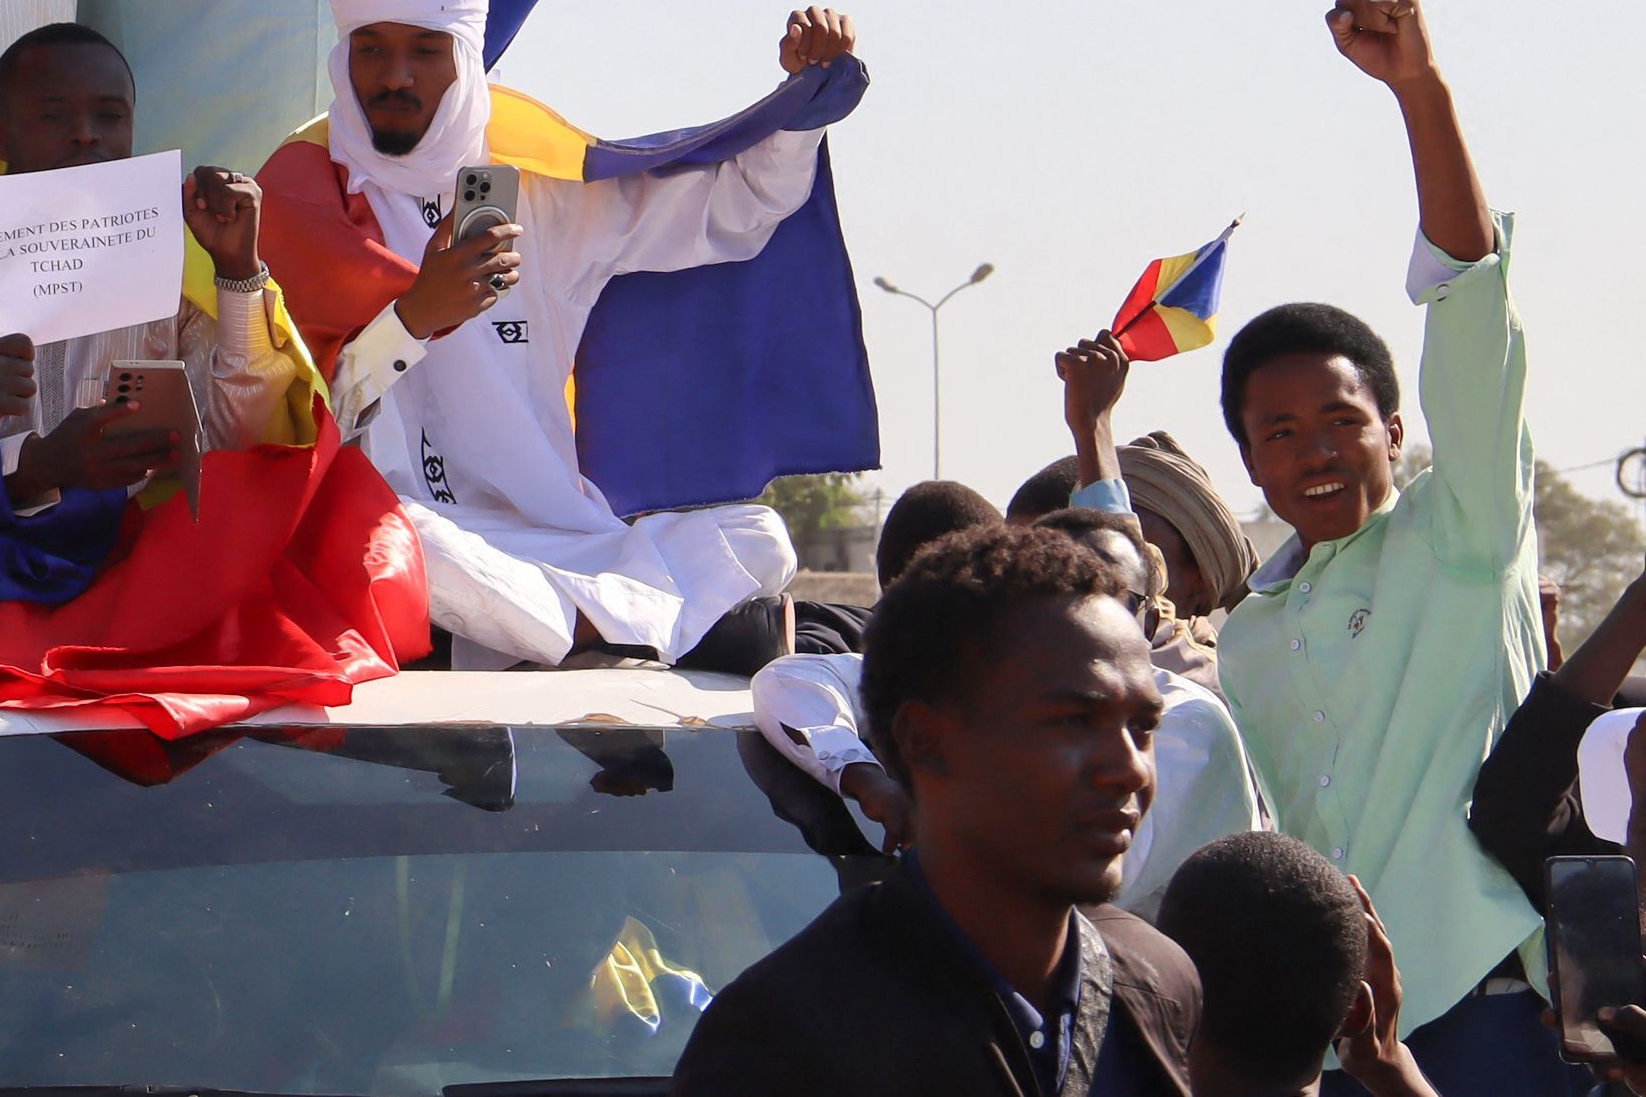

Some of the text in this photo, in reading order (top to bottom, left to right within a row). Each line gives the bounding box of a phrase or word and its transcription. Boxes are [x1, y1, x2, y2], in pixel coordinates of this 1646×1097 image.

[49, 220, 77, 232] DES
[81, 207, 159, 230] PATRIOTES
[137, 226, 156, 240] DU
[30, 258, 84, 274] TCHAD
[32, 280, 84, 300] (MPST)
